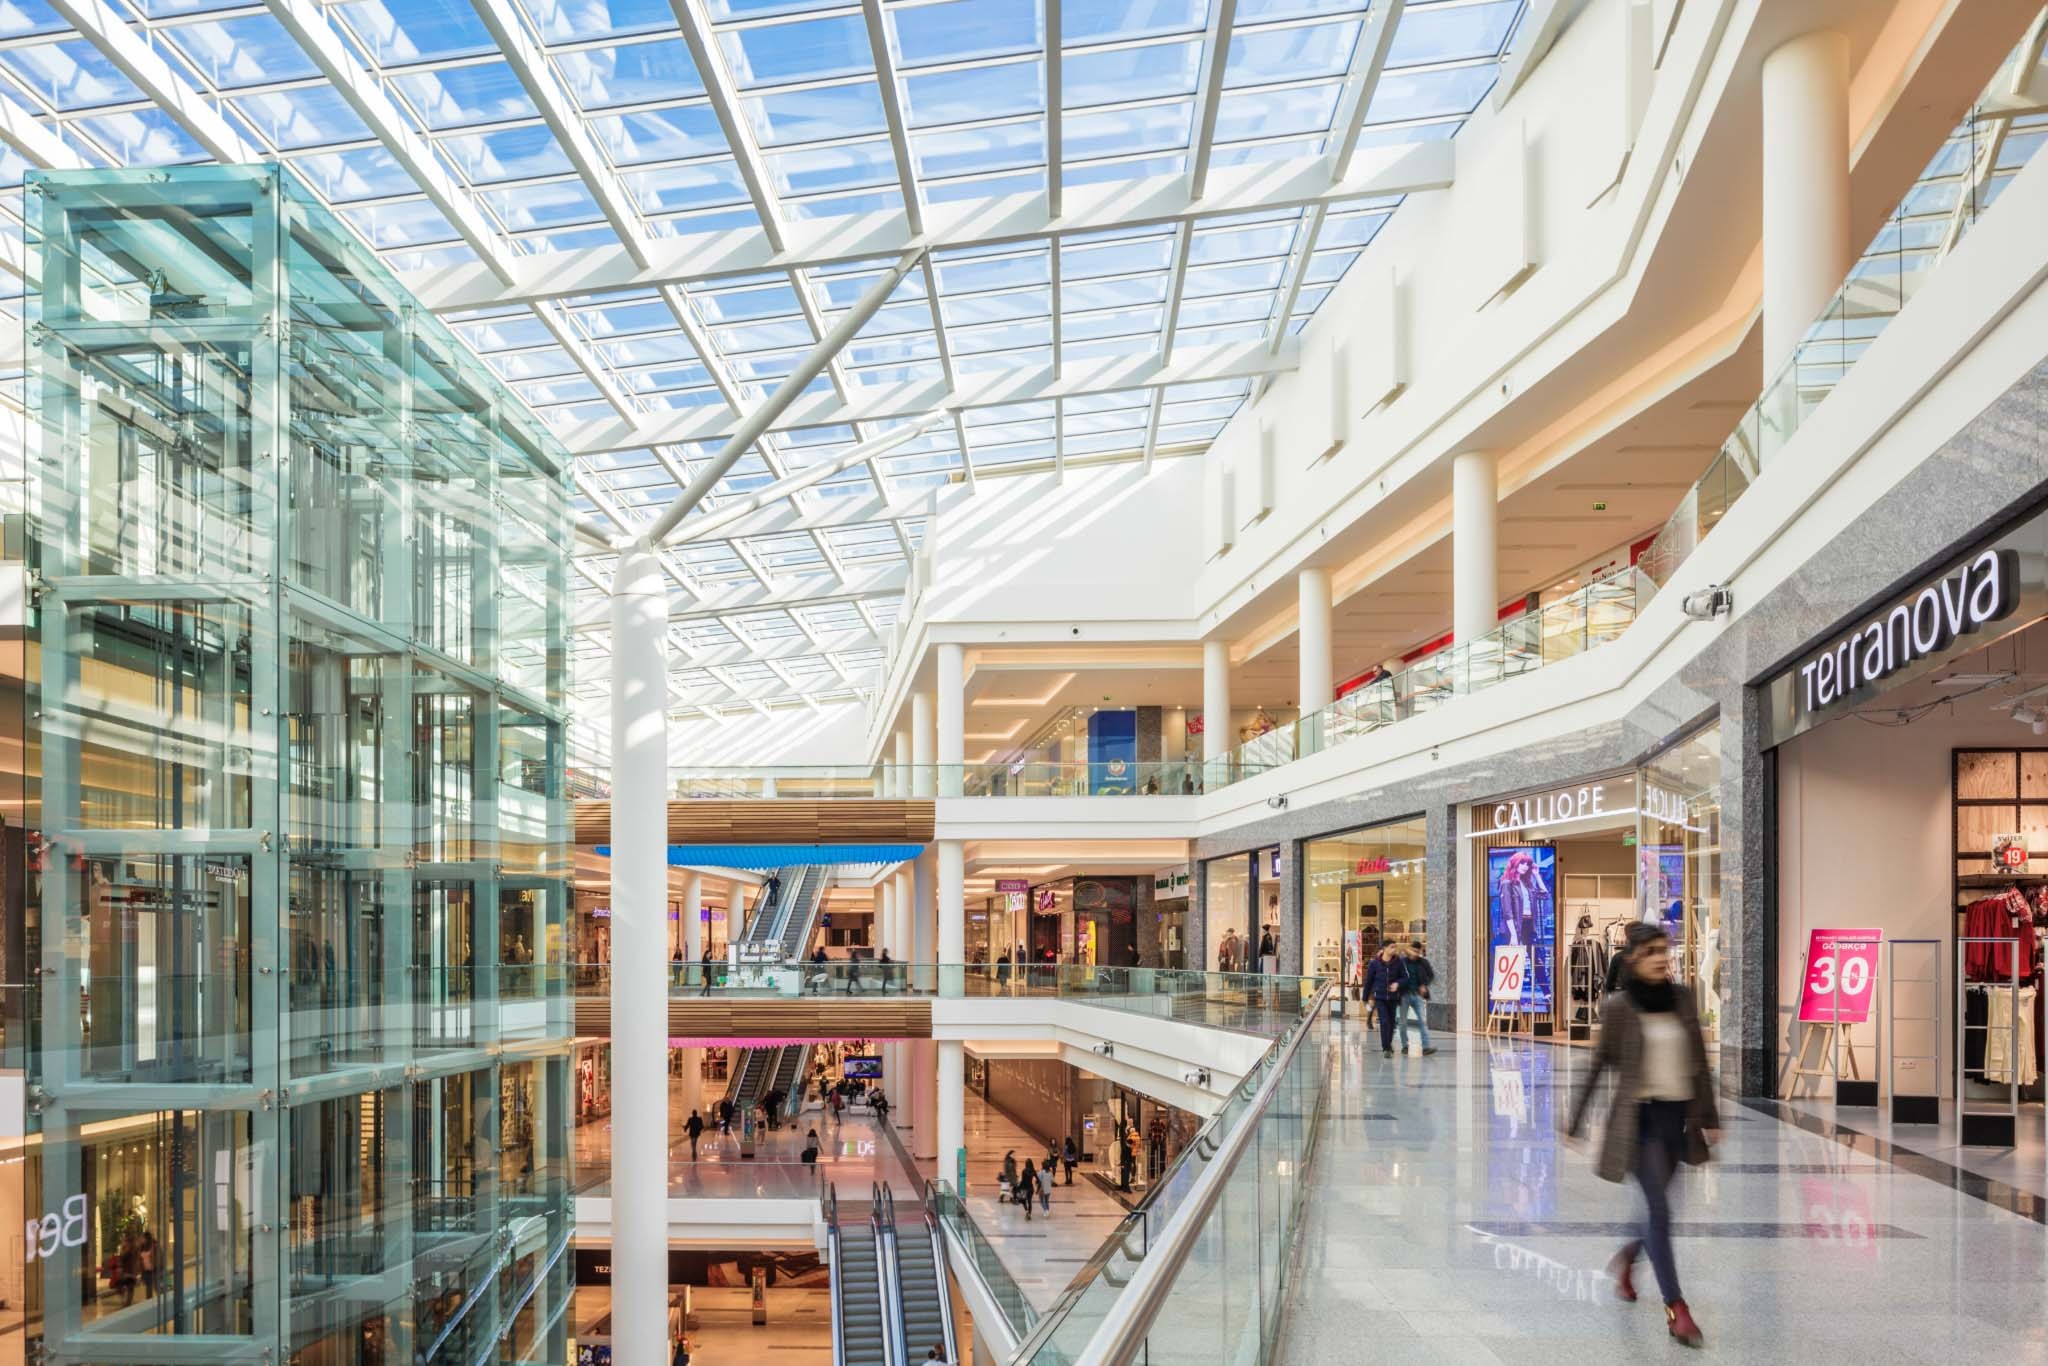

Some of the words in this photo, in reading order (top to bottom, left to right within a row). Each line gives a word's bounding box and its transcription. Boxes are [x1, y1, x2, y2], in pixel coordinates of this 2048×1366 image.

[1494, 787, 1604, 829] CALLIOPE
[2005, 849, 2021, 864] 19
[594, 1265, 612, 1273] TEZ
